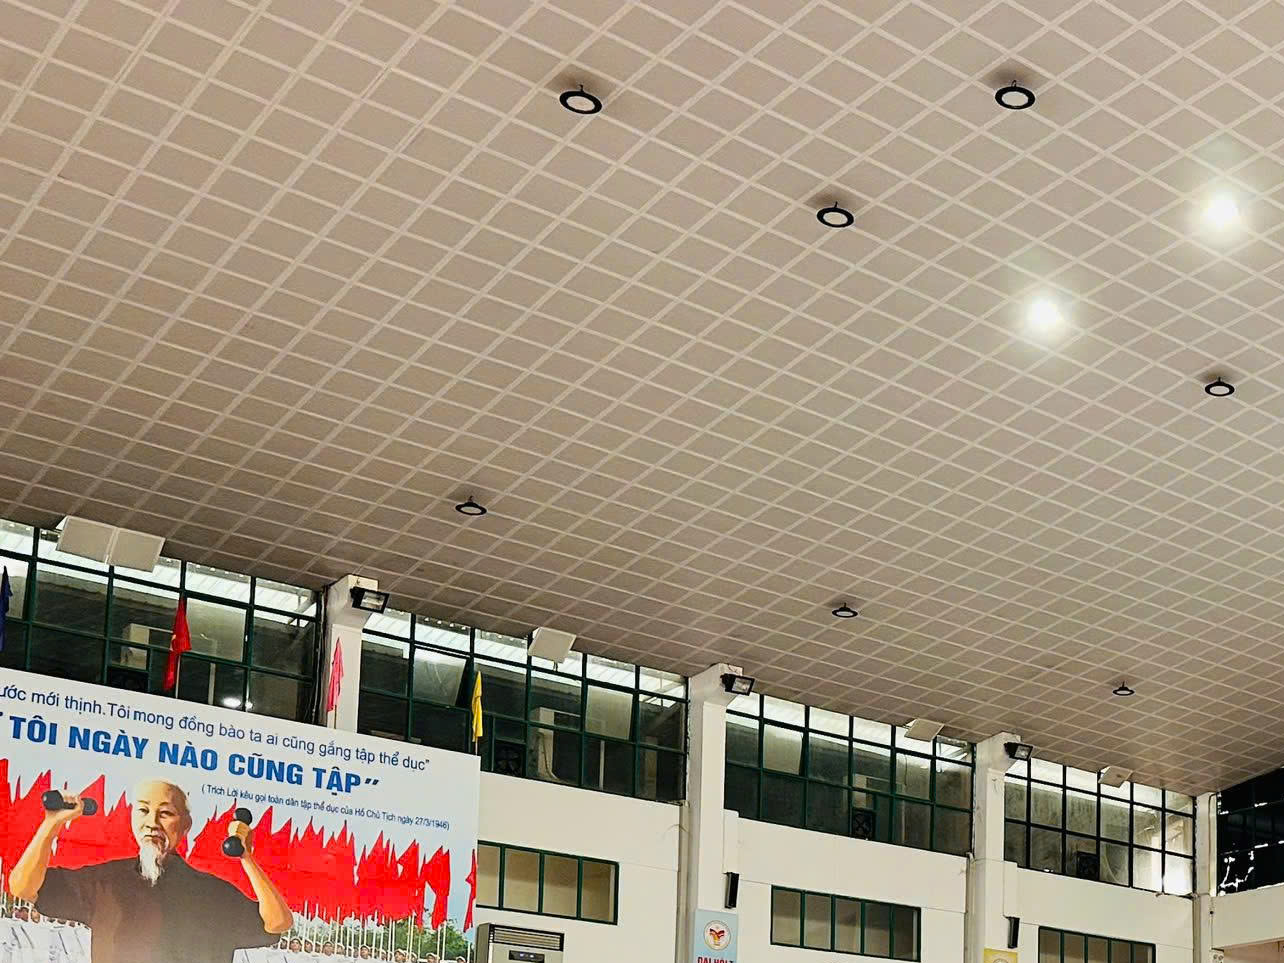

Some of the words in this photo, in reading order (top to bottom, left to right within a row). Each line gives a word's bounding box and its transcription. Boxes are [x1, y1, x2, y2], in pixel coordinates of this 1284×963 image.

[10, 714, 58, 745] TÔI
[69, 726, 149, 760] NGÀY
[158, 741, 218, 771] NÀO
[228, 753, 303, 786] CŨNG
[32, 692, 59, 707] mới
[133, 711, 174, 730] mong
[179, 716, 214, 737] đồng
[219, 723, 245, 740] bào
[250, 729, 262, 743] ta
[267, 733, 278, 746] ai
[282, 736, 315, 753] cũng
[319, 740, 351, 761] gắng
[356, 748, 376, 764] tập
[379, 752, 400, 767] thể
